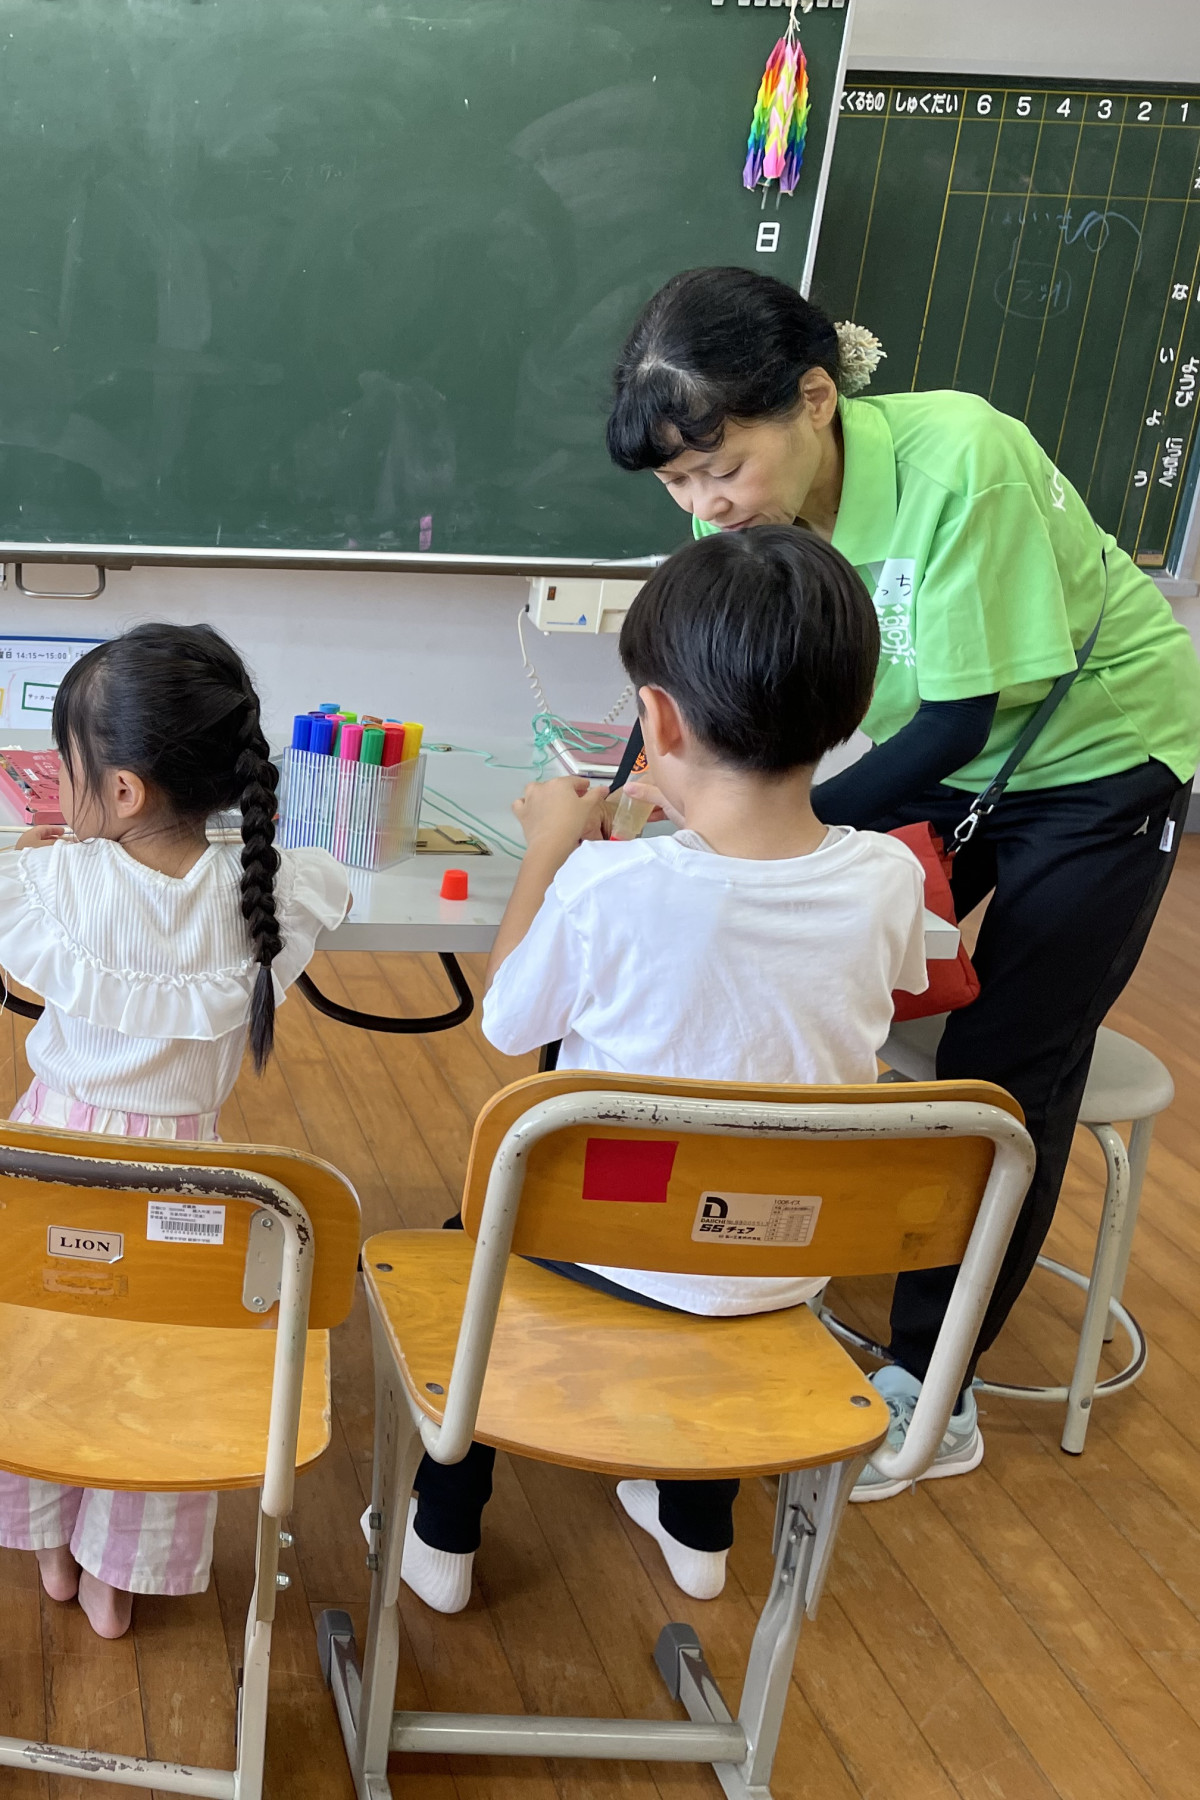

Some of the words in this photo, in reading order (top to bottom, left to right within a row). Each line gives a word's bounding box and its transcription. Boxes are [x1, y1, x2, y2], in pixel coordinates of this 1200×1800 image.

[896, 92, 959, 114] しゅくだい
[977, 94, 992, 115] 6
[1016, 96, 1031, 116] 5
[1057, 98, 1071, 118] 4
[1098, 99, 1113, 119] 3
[1137, 101, 1152, 121] 2
[1181, 102, 1189, 122] 1
[755, 221, 781, 253] 日
[1175, 356, 1200, 407] ようび
[60, 1236, 110, 1252] LION
